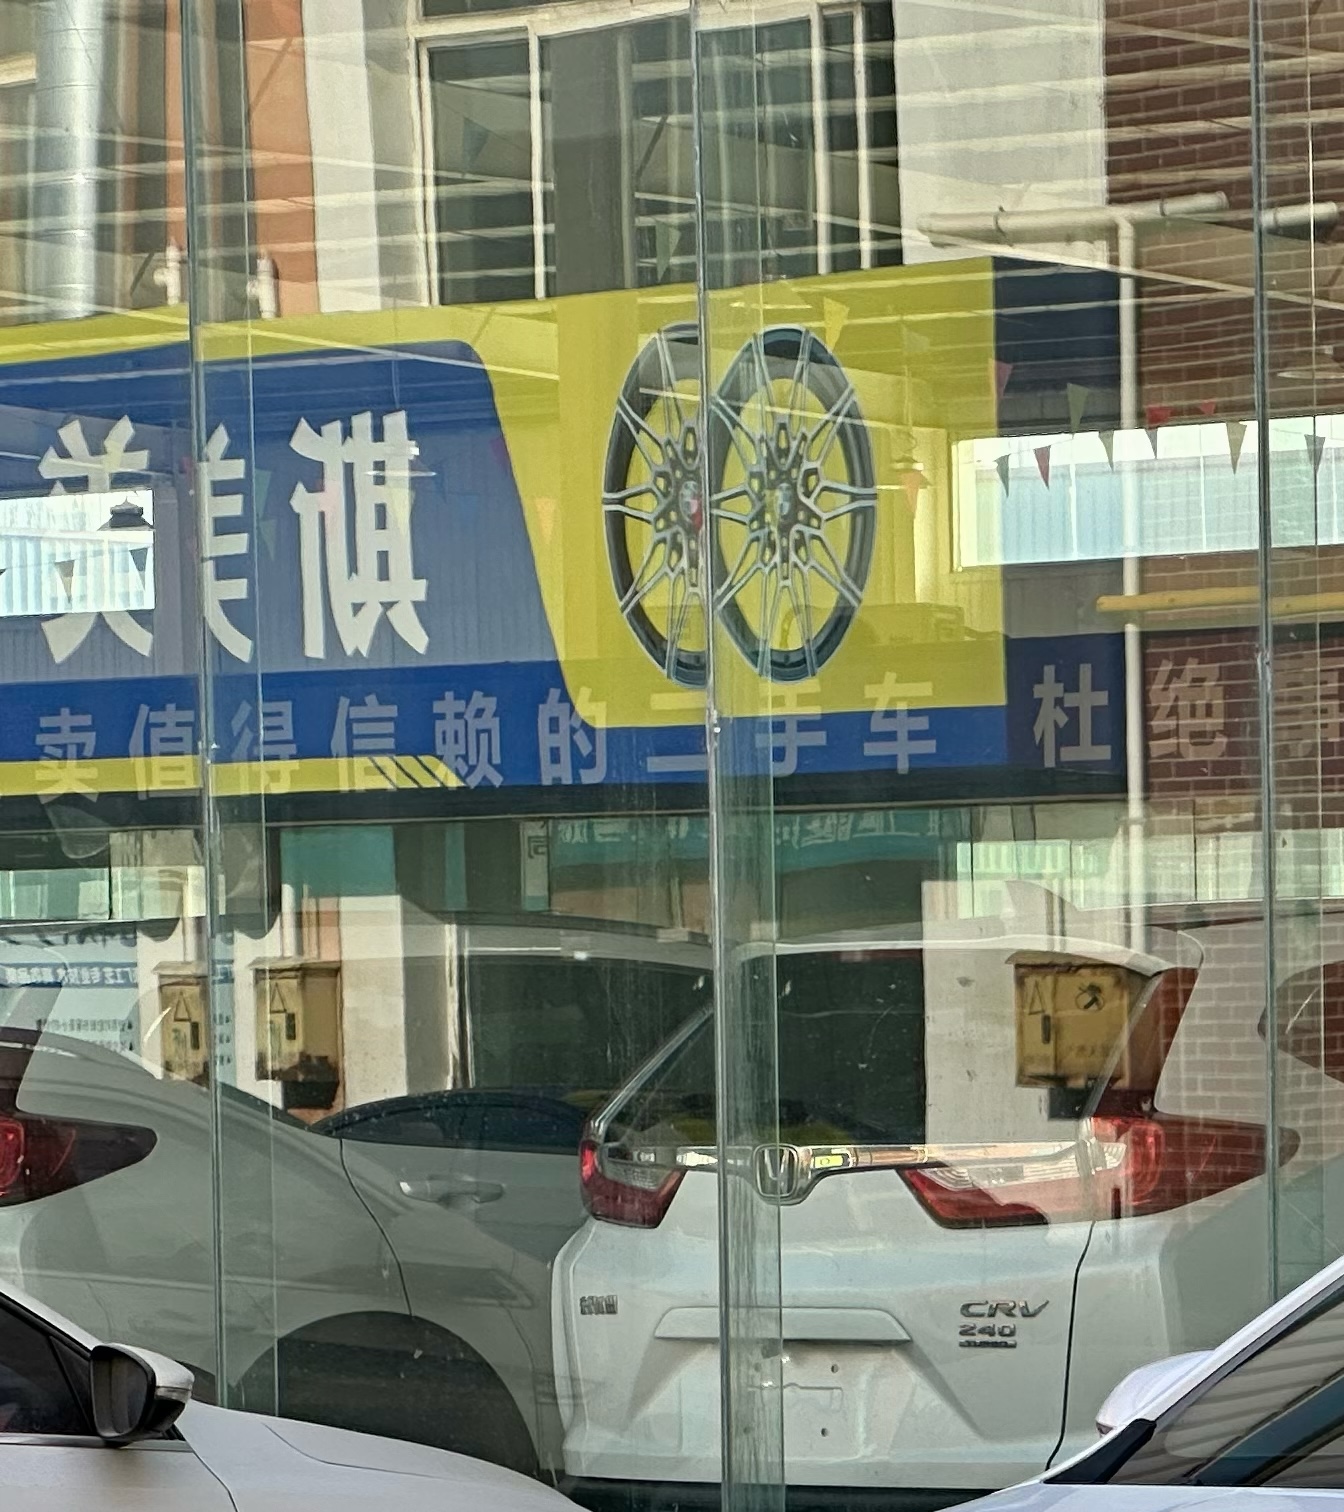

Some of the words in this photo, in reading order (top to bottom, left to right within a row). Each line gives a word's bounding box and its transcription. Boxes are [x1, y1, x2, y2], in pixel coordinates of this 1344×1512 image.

[35, 672, 936, 803] 卖值得信赖的二手车
[959, 1299, 1050, 1318] CRV
[958, 1323, 1017, 1337] 240
